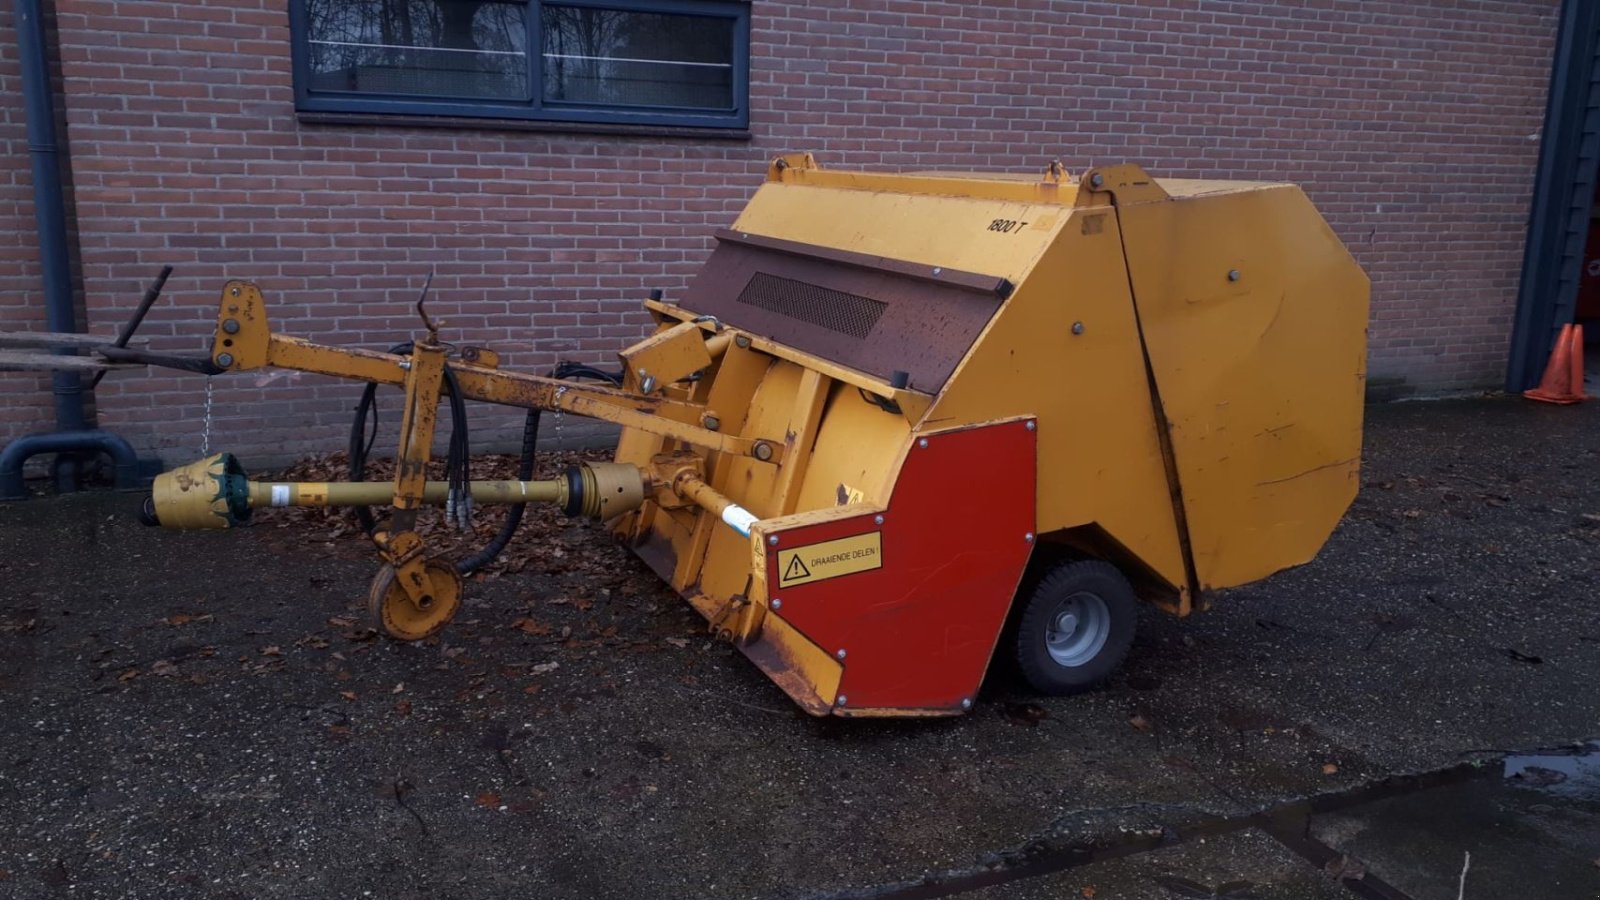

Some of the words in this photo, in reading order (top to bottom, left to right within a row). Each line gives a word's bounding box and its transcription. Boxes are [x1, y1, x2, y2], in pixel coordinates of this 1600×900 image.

[987, 219, 1016, 233] 1800
[1014, 222, 1029, 234] T
[811, 551, 851, 567] DRAAIENDE
[852, 548, 875, 559] DELEN
